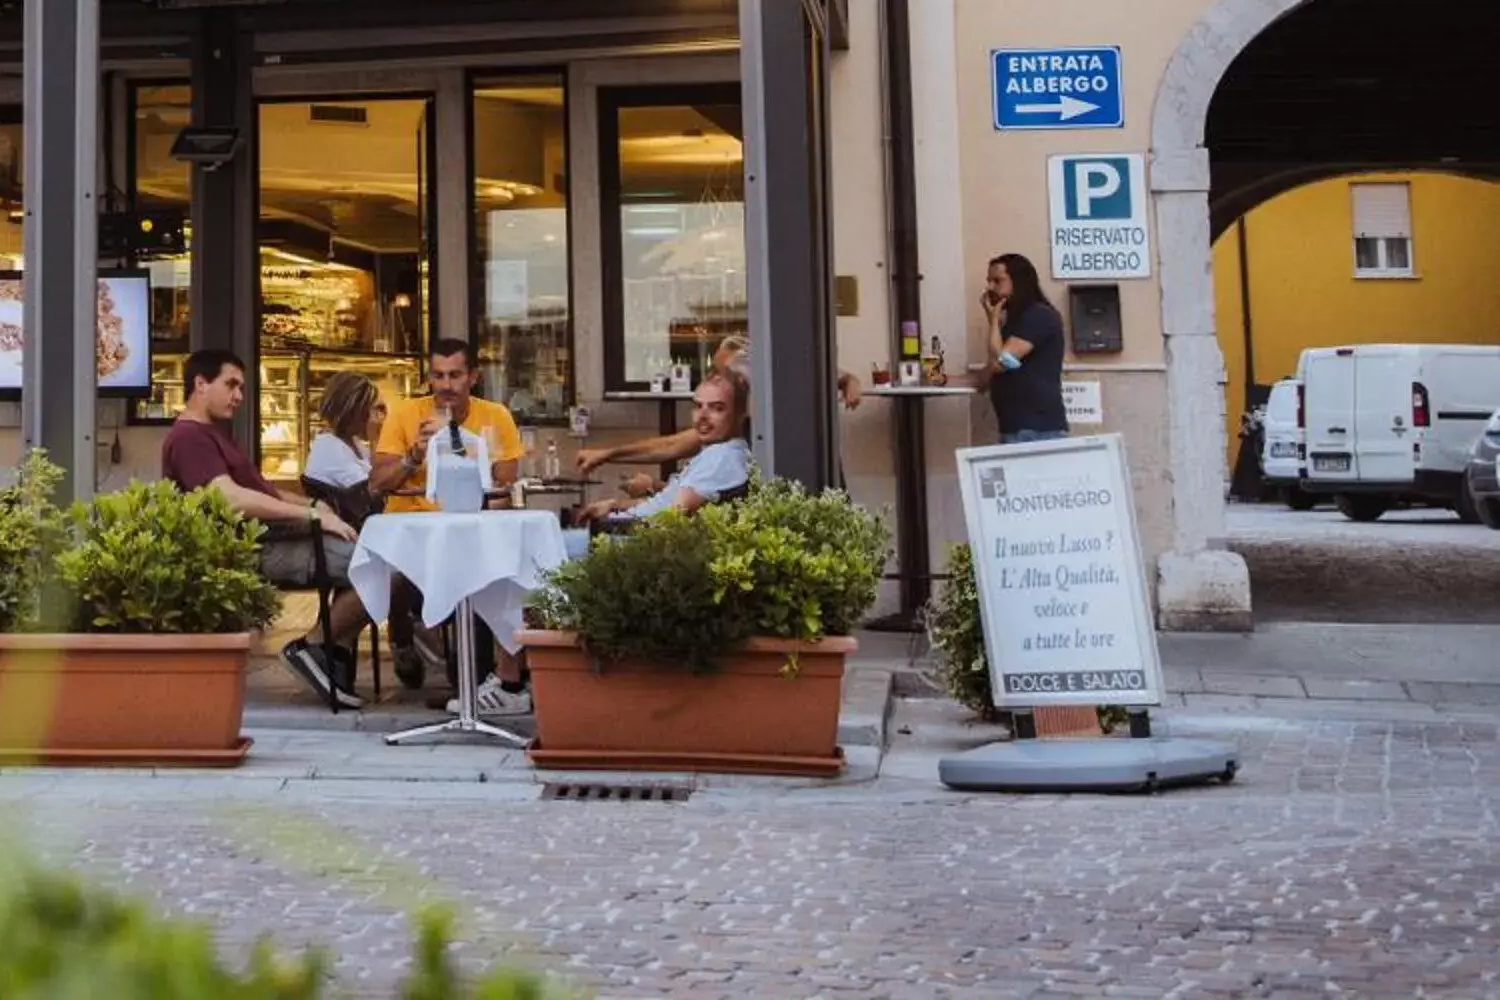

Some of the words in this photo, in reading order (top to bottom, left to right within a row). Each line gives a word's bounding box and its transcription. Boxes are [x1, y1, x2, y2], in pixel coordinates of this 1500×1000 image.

[1008, 55, 1104, 74] ENTRATA
[1006, 75, 1109, 94] ALBERGO
[1074, 161, 1122, 217] P
[1055, 226, 1145, 247] RISERVATO
[1061, 251, 1141, 272] ALBERGO
[995, 489, 1112, 515] MONTENEGRO
[1009, 674, 1061, 692] DOLCE
[1067, 675, 1077, 690] E
[1082, 672, 1141, 691] SALATO
